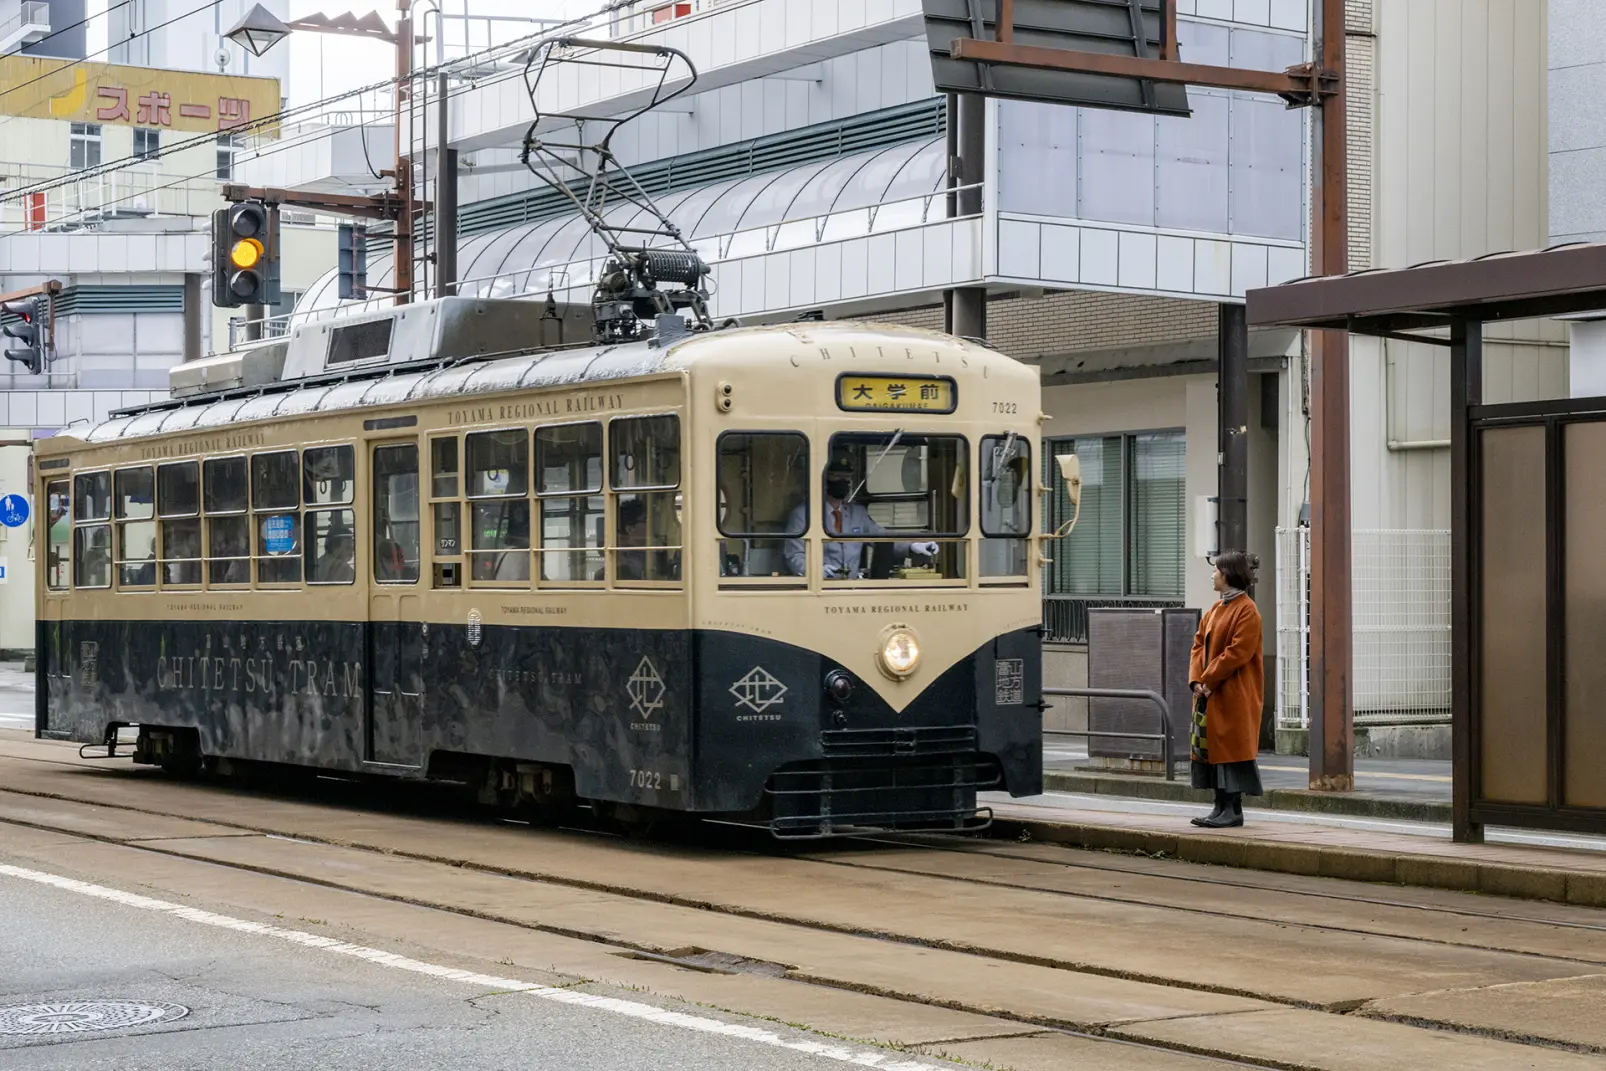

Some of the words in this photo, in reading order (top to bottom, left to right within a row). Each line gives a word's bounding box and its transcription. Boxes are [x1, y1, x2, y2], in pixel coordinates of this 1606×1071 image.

[97, 87, 250, 131] スポーツ
[852, 384, 939, 400] 大学前
[447, 408, 493, 425] TOYAMA
[500, 400, 560, 419] REGIONAL
[566, 394, 624, 412] RAILWAY
[992, 402, 1017, 414] 7022
[141, 445, 174, 459] TOYAMA
[178, 438, 220, 455] REGIONAL
[226, 433, 265, 448] RAILWAY
[825, 606, 866, 614] TOYAMA
[871, 605, 920, 613] REGIONAL
[924, 603, 969, 612] RAILWAY
[157, 656, 274, 693] CHITETSU
[288, 659, 361, 697] TRAM
[630, 722, 661, 731] CHITETSU
[629, 769, 662, 790] 7022
